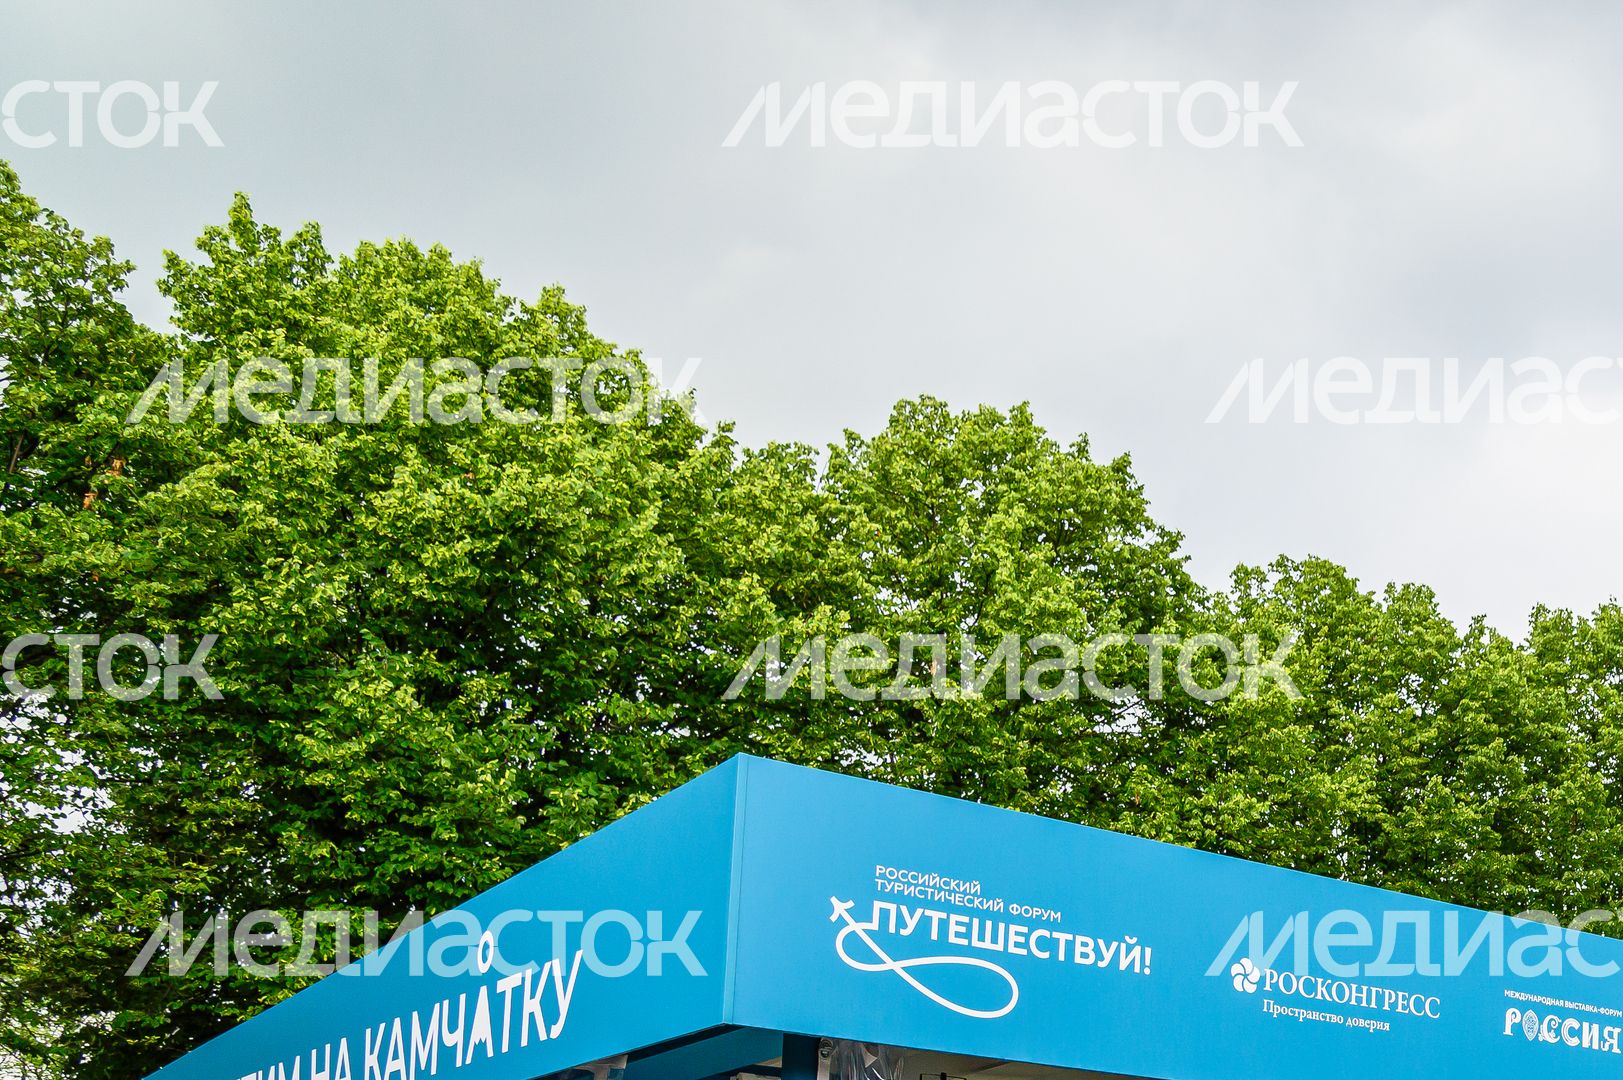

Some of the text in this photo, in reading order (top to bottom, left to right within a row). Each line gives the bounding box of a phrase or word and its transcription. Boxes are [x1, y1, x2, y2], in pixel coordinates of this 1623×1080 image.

[875, 865, 981, 895] РОССИЙСКИЙ
[875, 879, 1062, 924] ТУРИСТИЧЕСКИЙ ФОРУМ
[870, 900, 1152, 976] ПУТЕШЕСТВУЙ!
[1263, 999, 1390, 1033] Пространство доверия
[1264, 969, 1441, 1019] РОСКОНГРЕСС
[1504, 989, 1622, 1018] МЕЖДУНАРОДНАЯ ВЫСТАВКА-ФОРУМ
[1503, 1007, 1622, 1054] РОССИЯ
